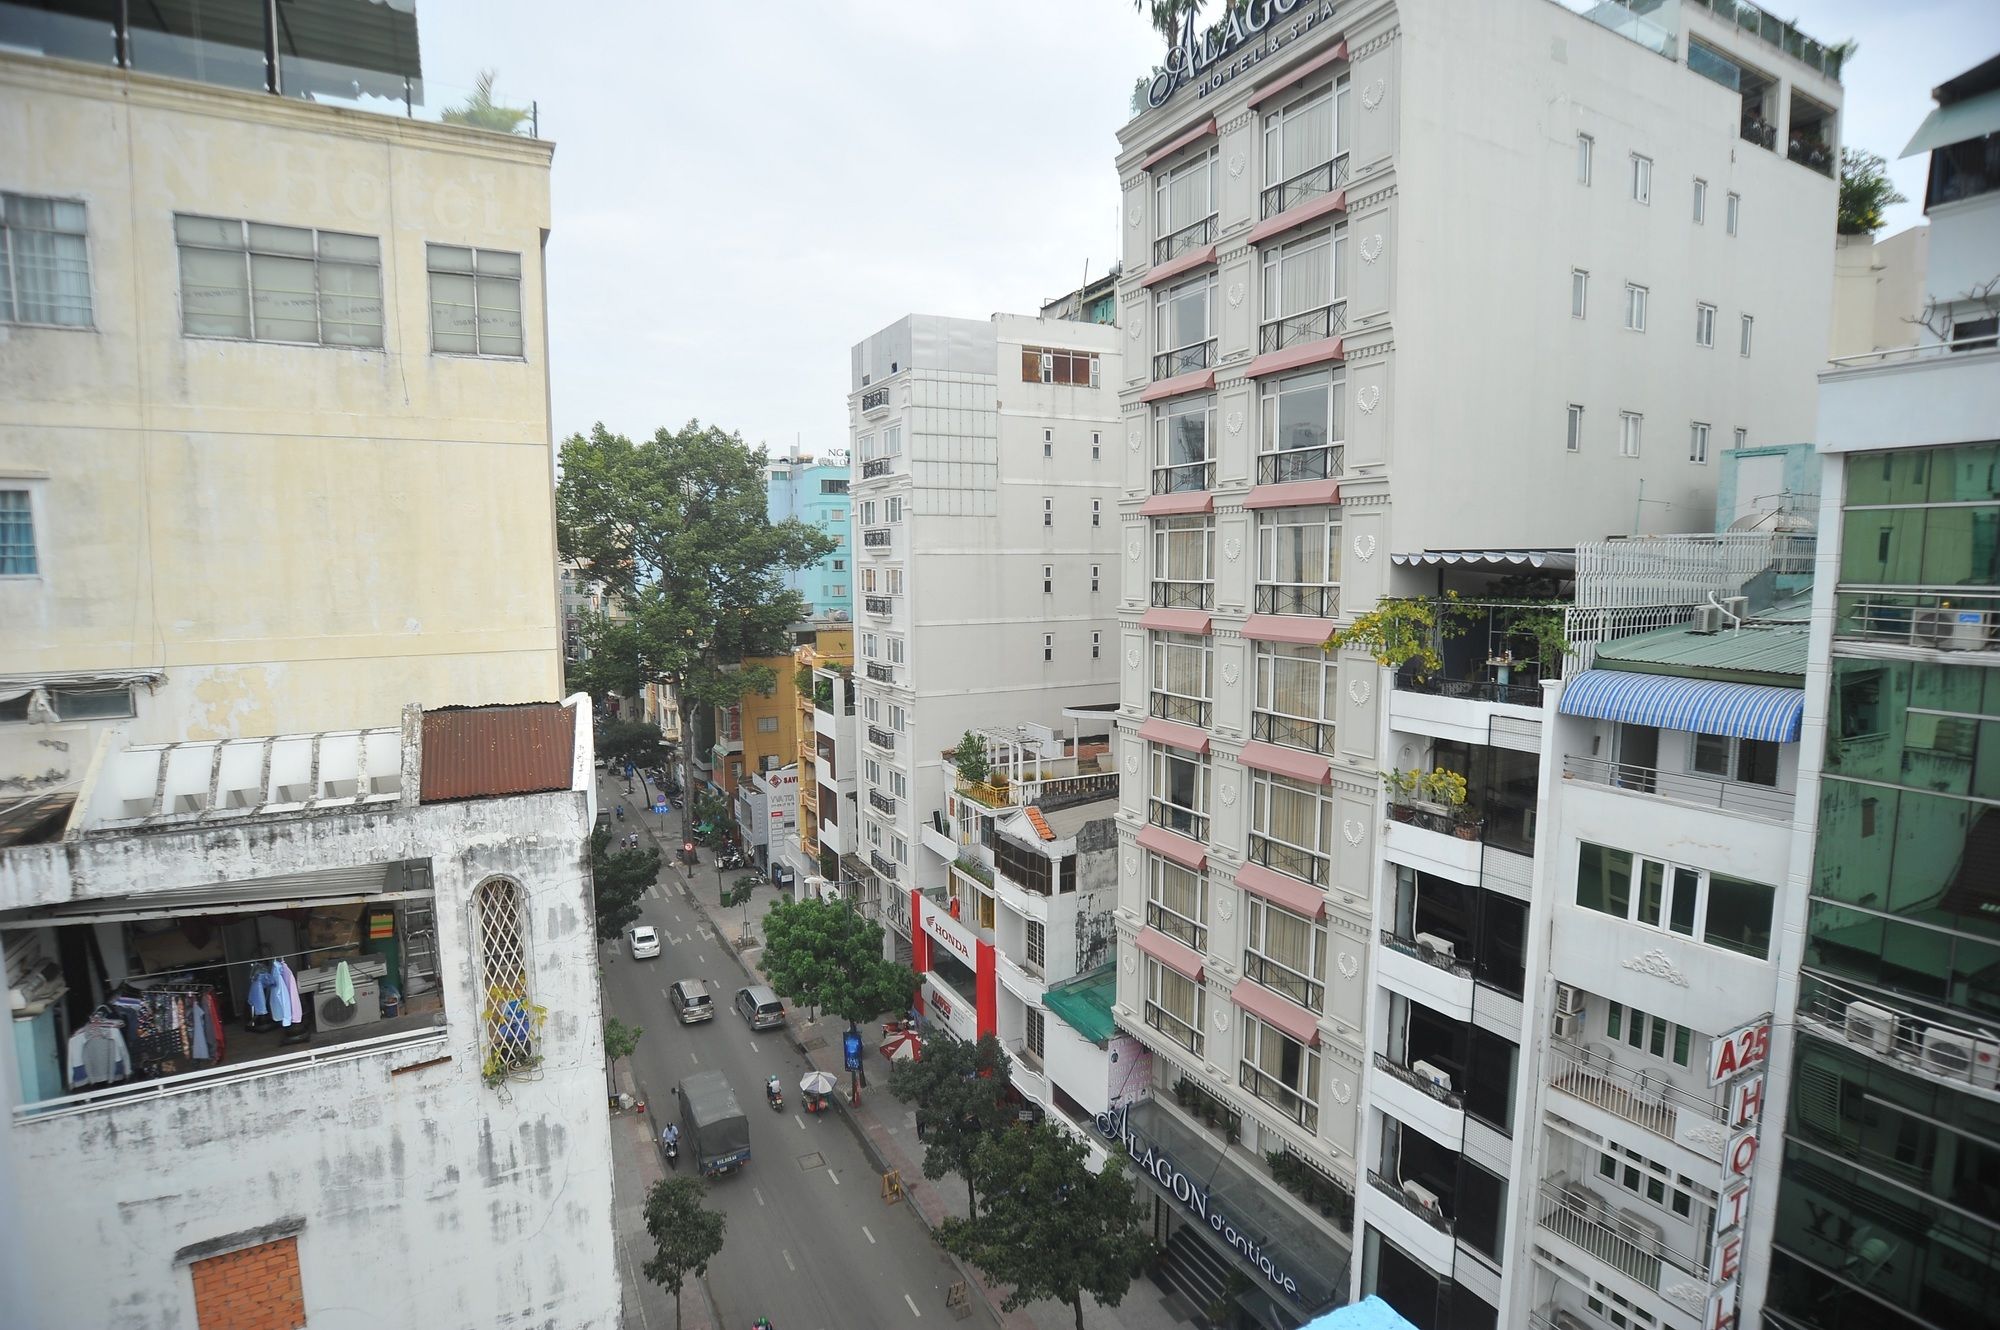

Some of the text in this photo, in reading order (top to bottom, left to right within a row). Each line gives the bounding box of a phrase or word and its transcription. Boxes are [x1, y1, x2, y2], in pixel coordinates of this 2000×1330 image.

[1197, 2, 1333, 99] HOTEL & SPA
[934, 922, 970, 959] HONDA
[1713, 1023, 1771, 1080] A25
[1095, 1103, 1297, 1294] ALAGON d'antique
[1713, 1079, 1762, 1330] HOTEL
